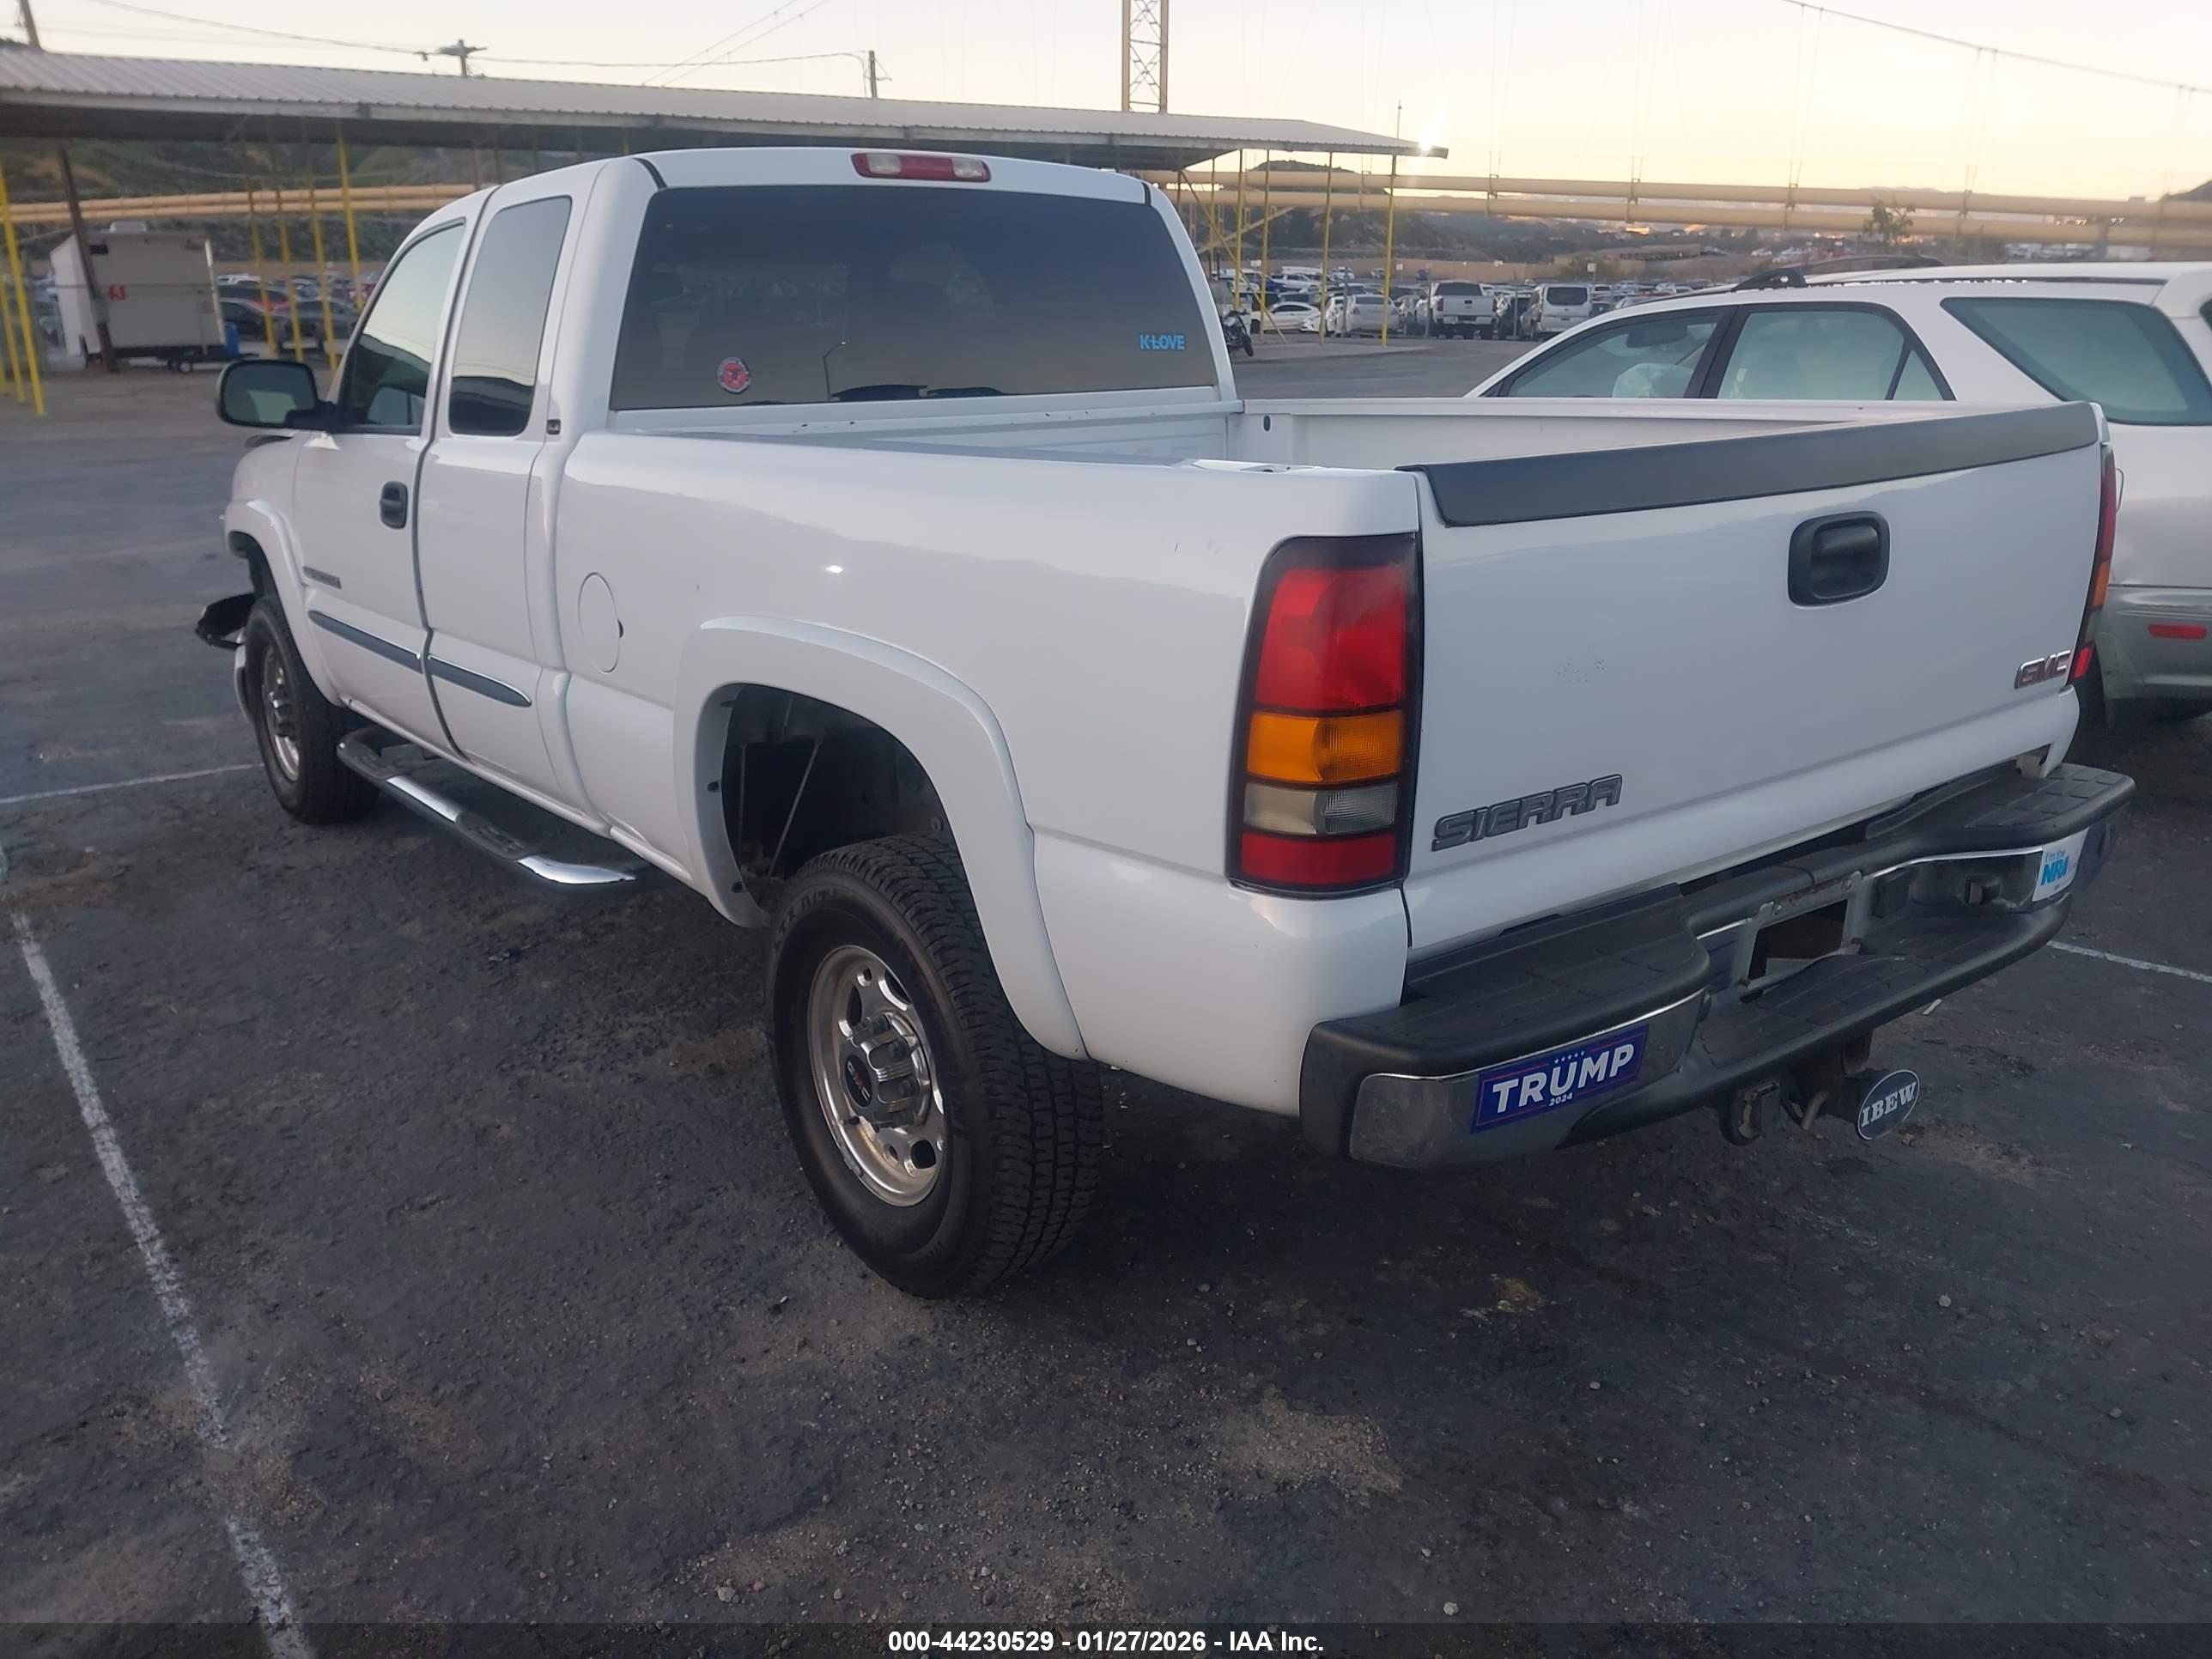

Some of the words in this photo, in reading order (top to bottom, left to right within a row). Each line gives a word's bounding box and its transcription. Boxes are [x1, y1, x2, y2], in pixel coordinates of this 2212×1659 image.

[2014, 650, 2071, 689] GMC
[1431, 774, 1622, 852] SIERRA
[1492, 1044, 1634, 1113] TRUMP
[1549, 1092, 1572, 1107] 2024
[1861, 1081, 1917, 1127] IBEW
